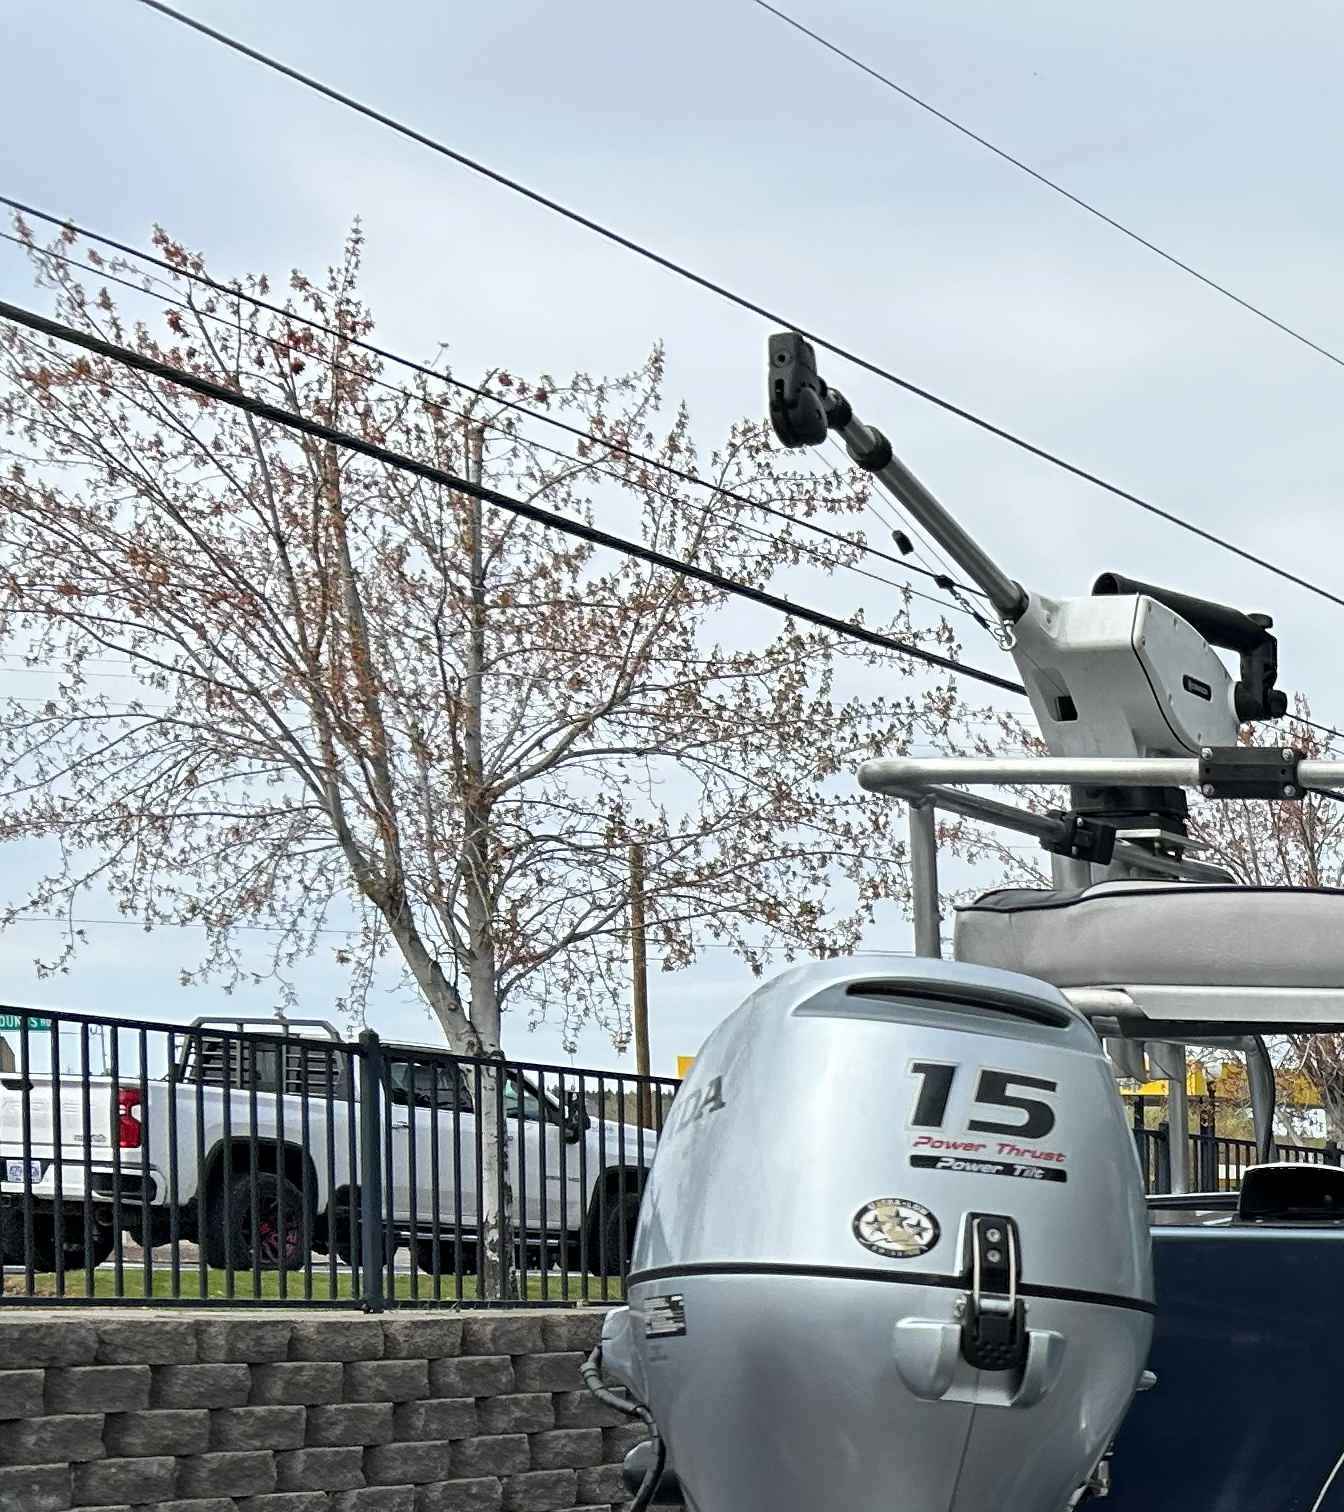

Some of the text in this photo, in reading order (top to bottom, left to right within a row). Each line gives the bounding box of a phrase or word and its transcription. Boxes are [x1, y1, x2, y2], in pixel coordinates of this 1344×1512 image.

[908, 1060, 1058, 1140] 15
[912, 1136, 1067, 1163] Power Thrust
[936, 1157, 1045, 1180] Power Tilt
